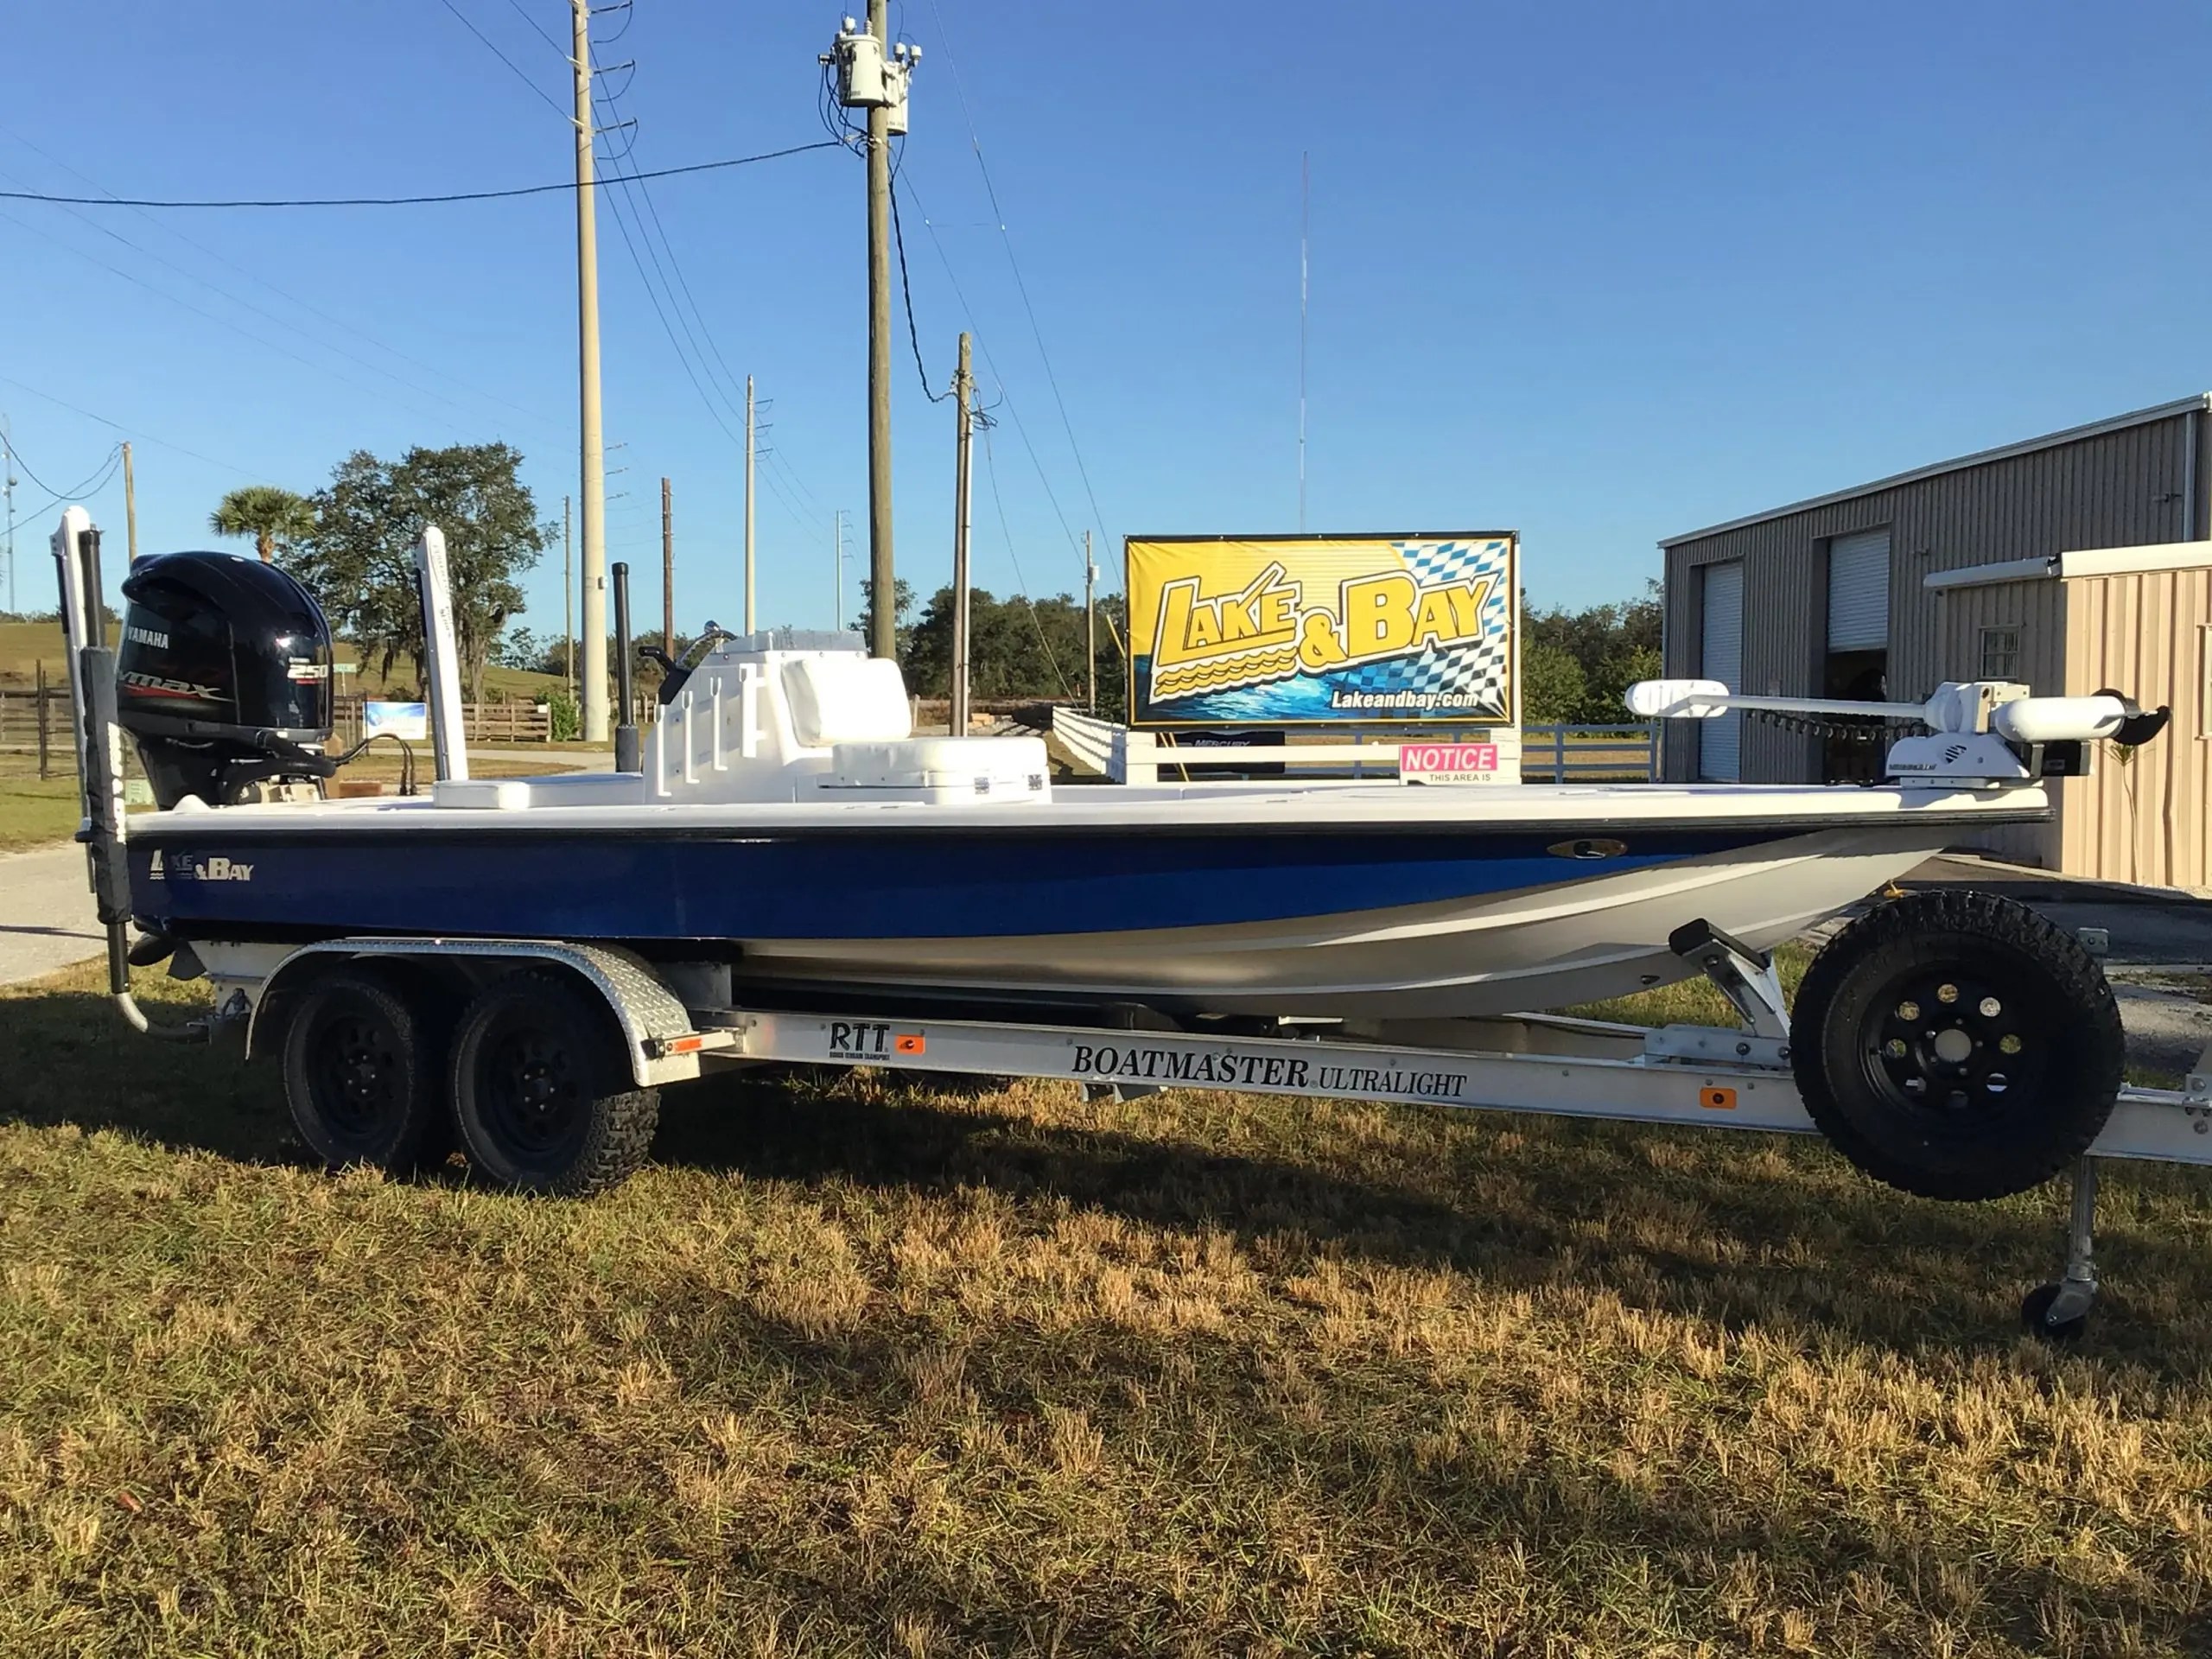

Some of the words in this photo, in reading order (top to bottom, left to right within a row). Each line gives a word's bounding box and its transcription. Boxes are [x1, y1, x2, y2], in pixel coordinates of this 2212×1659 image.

[1157, 569, 1297, 666] LAKE
[1298, 613, 1348, 667] &
[1346, 576, 1489, 658] BAY
[128, 626, 169, 649] YAMAHA
[287, 664, 328, 679] 250
[1331, 690, 1478, 711] Lakeandbay.com
[1405, 747, 1493, 771] NOTICE
[1429, 773, 1451, 782] THIS
[1481, 773, 1491, 782] IS
[208, 857, 254, 880] BAY
[830, 1022, 890, 1052] RTT
[1071, 1046, 1310, 1088] BOATMASTER
[1319, 1066, 1468, 1097] ULTRALIGHT
